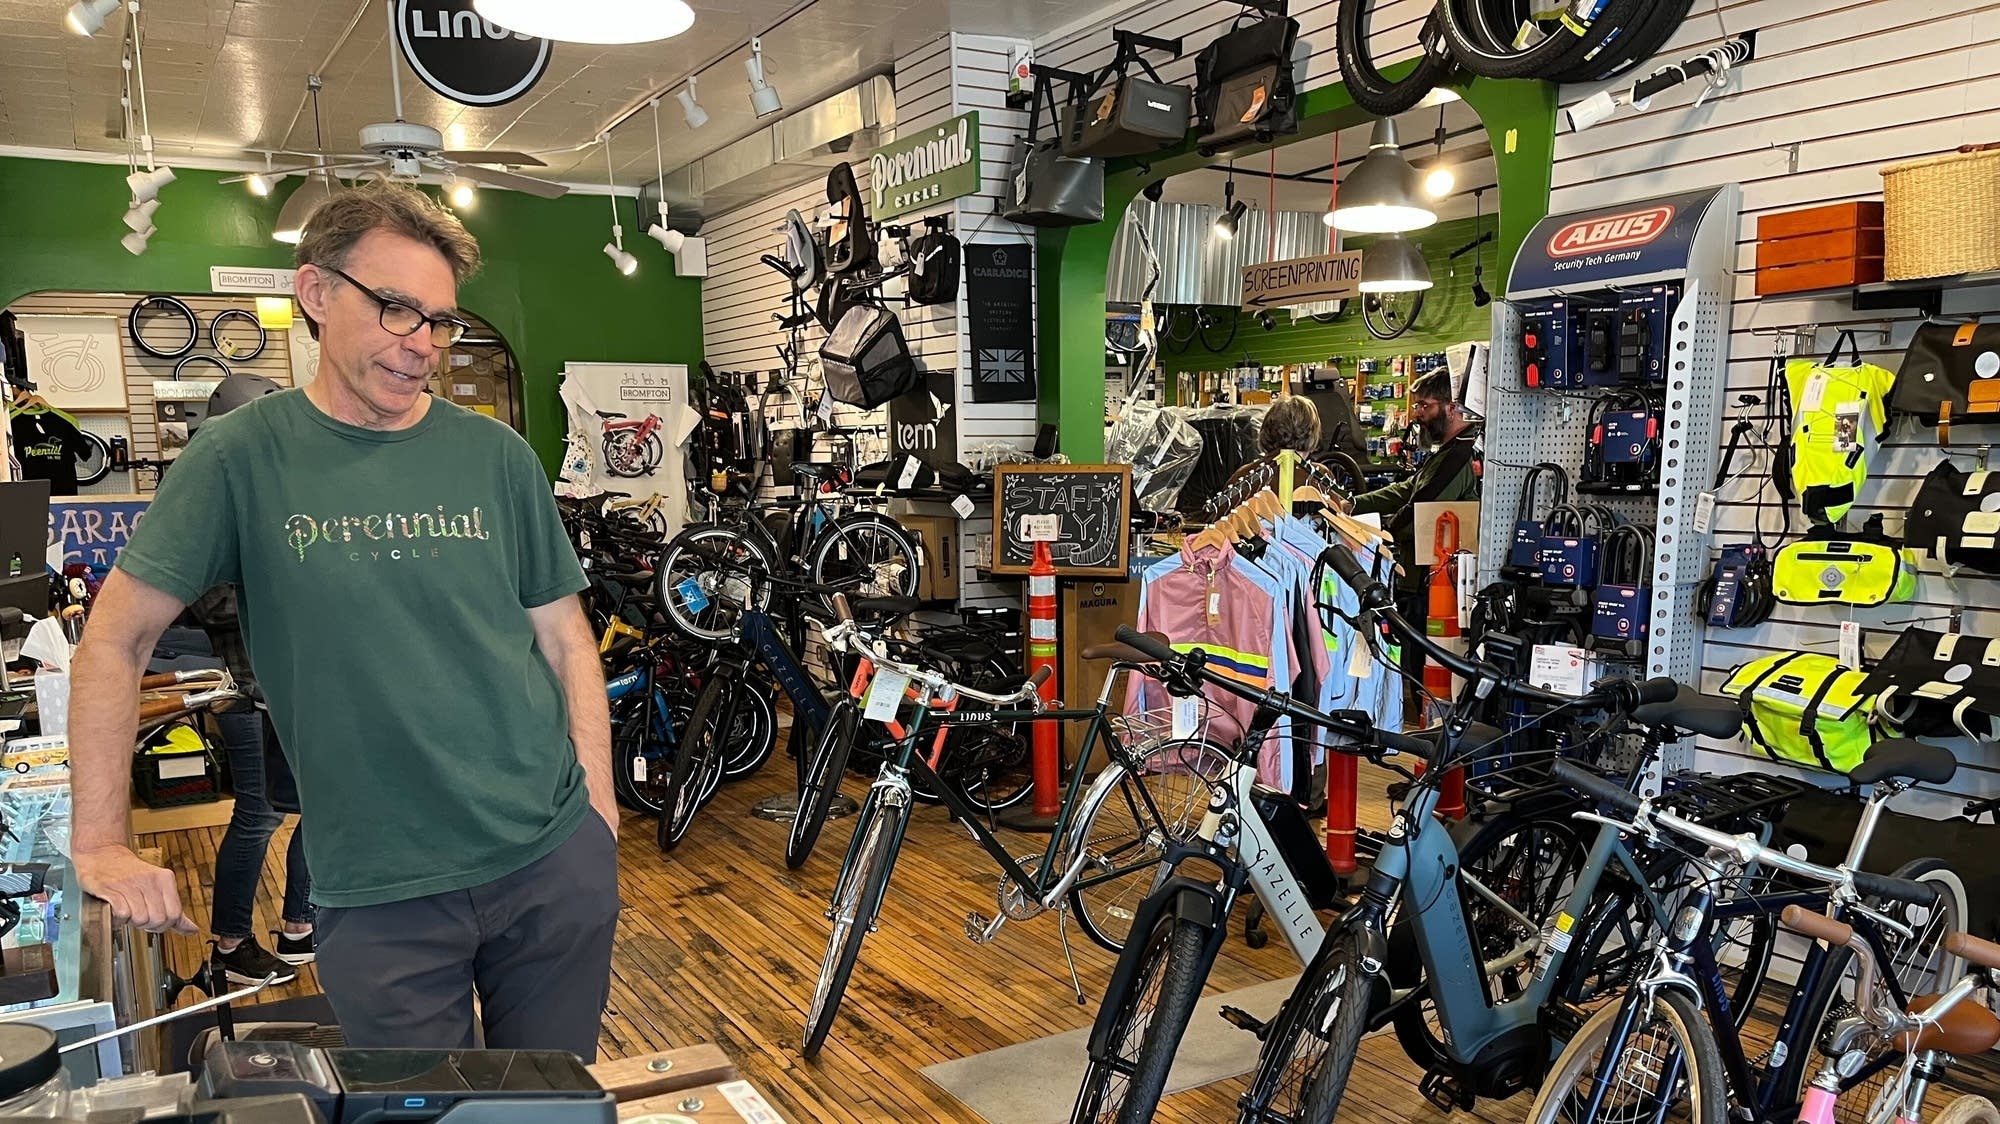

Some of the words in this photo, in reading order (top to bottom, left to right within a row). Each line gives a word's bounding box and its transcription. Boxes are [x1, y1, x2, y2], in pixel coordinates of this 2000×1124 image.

[412, 10, 534, 41] LINU
[871, 118, 972, 209] Perennial
[894, 184, 939, 208] CYCLE
[1561, 213, 1659, 248] ABUS
[972, 267, 1028, 278] CARRADICE
[1244, 258, 1360, 293] SCREENPRINTING
[1553, 258, 1584, 271] Security
[1585, 255, 1602, 266] Tech
[1604, 250, 1641, 263] Germany
[221, 275, 273, 285] BROMPTON
[897, 420, 937, 450] tern
[1010, 482, 1106, 513] STAFF
[285, 505, 489, 562] Perennial
[350, 548, 440, 561] CYCLE
[1080, 598, 1118, 609] MAGURA
[763, 644, 816, 713] GAZELLE
[960, 712, 992, 721] LINUS
[1256, 849, 1313, 939] GAZELLE
